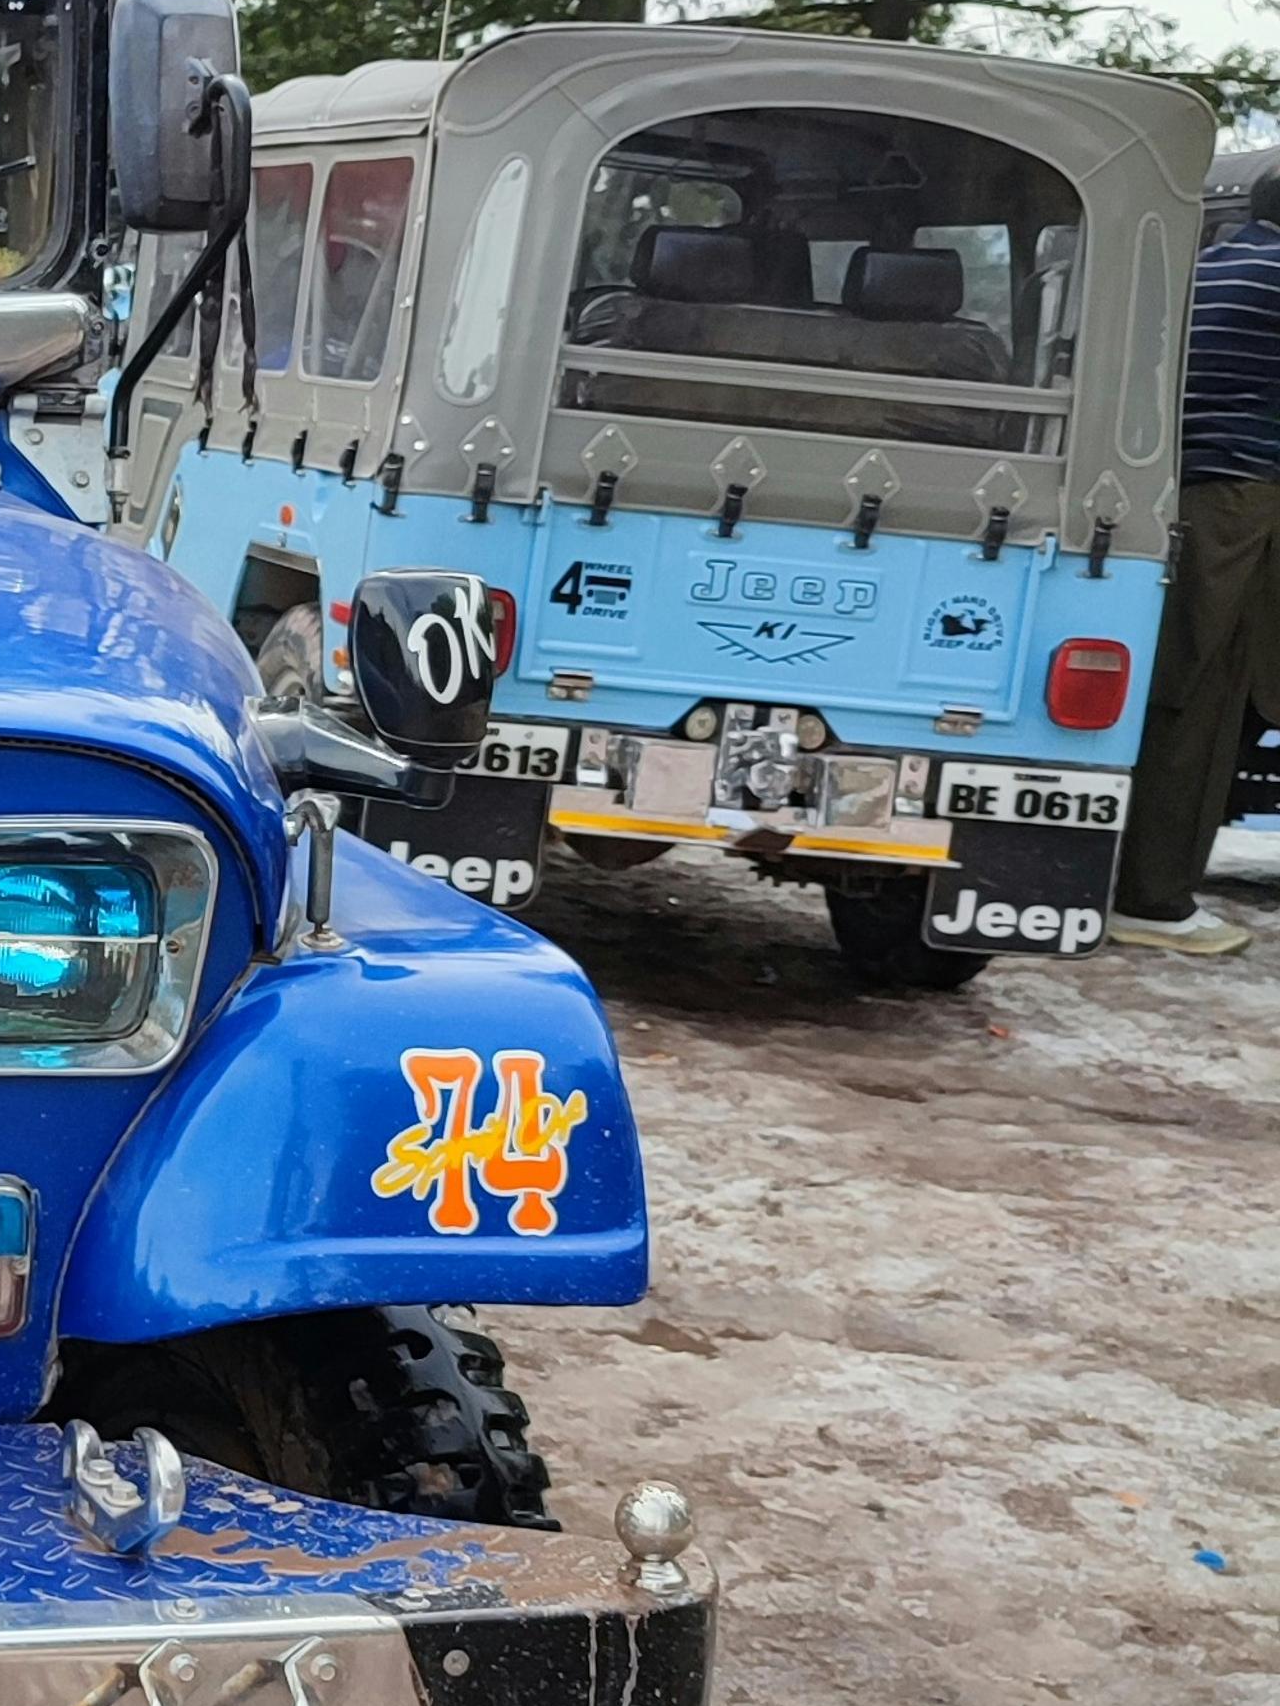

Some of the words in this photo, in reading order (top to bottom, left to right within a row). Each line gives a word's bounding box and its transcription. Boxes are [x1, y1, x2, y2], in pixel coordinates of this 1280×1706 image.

[549, 560, 583, 615] 4
[585, 562, 632, 575] WHEEL
[582, 606, 628, 619] DRIVE
[690, 559, 878, 615] Jeep
[407, 575, 496, 705] OK
[948, 783, 999, 815] BE
[1014, 788, 1120, 824] 0613
[931, 889, 1103, 954] Jeep
[400, 1048, 568, 1236] 74
